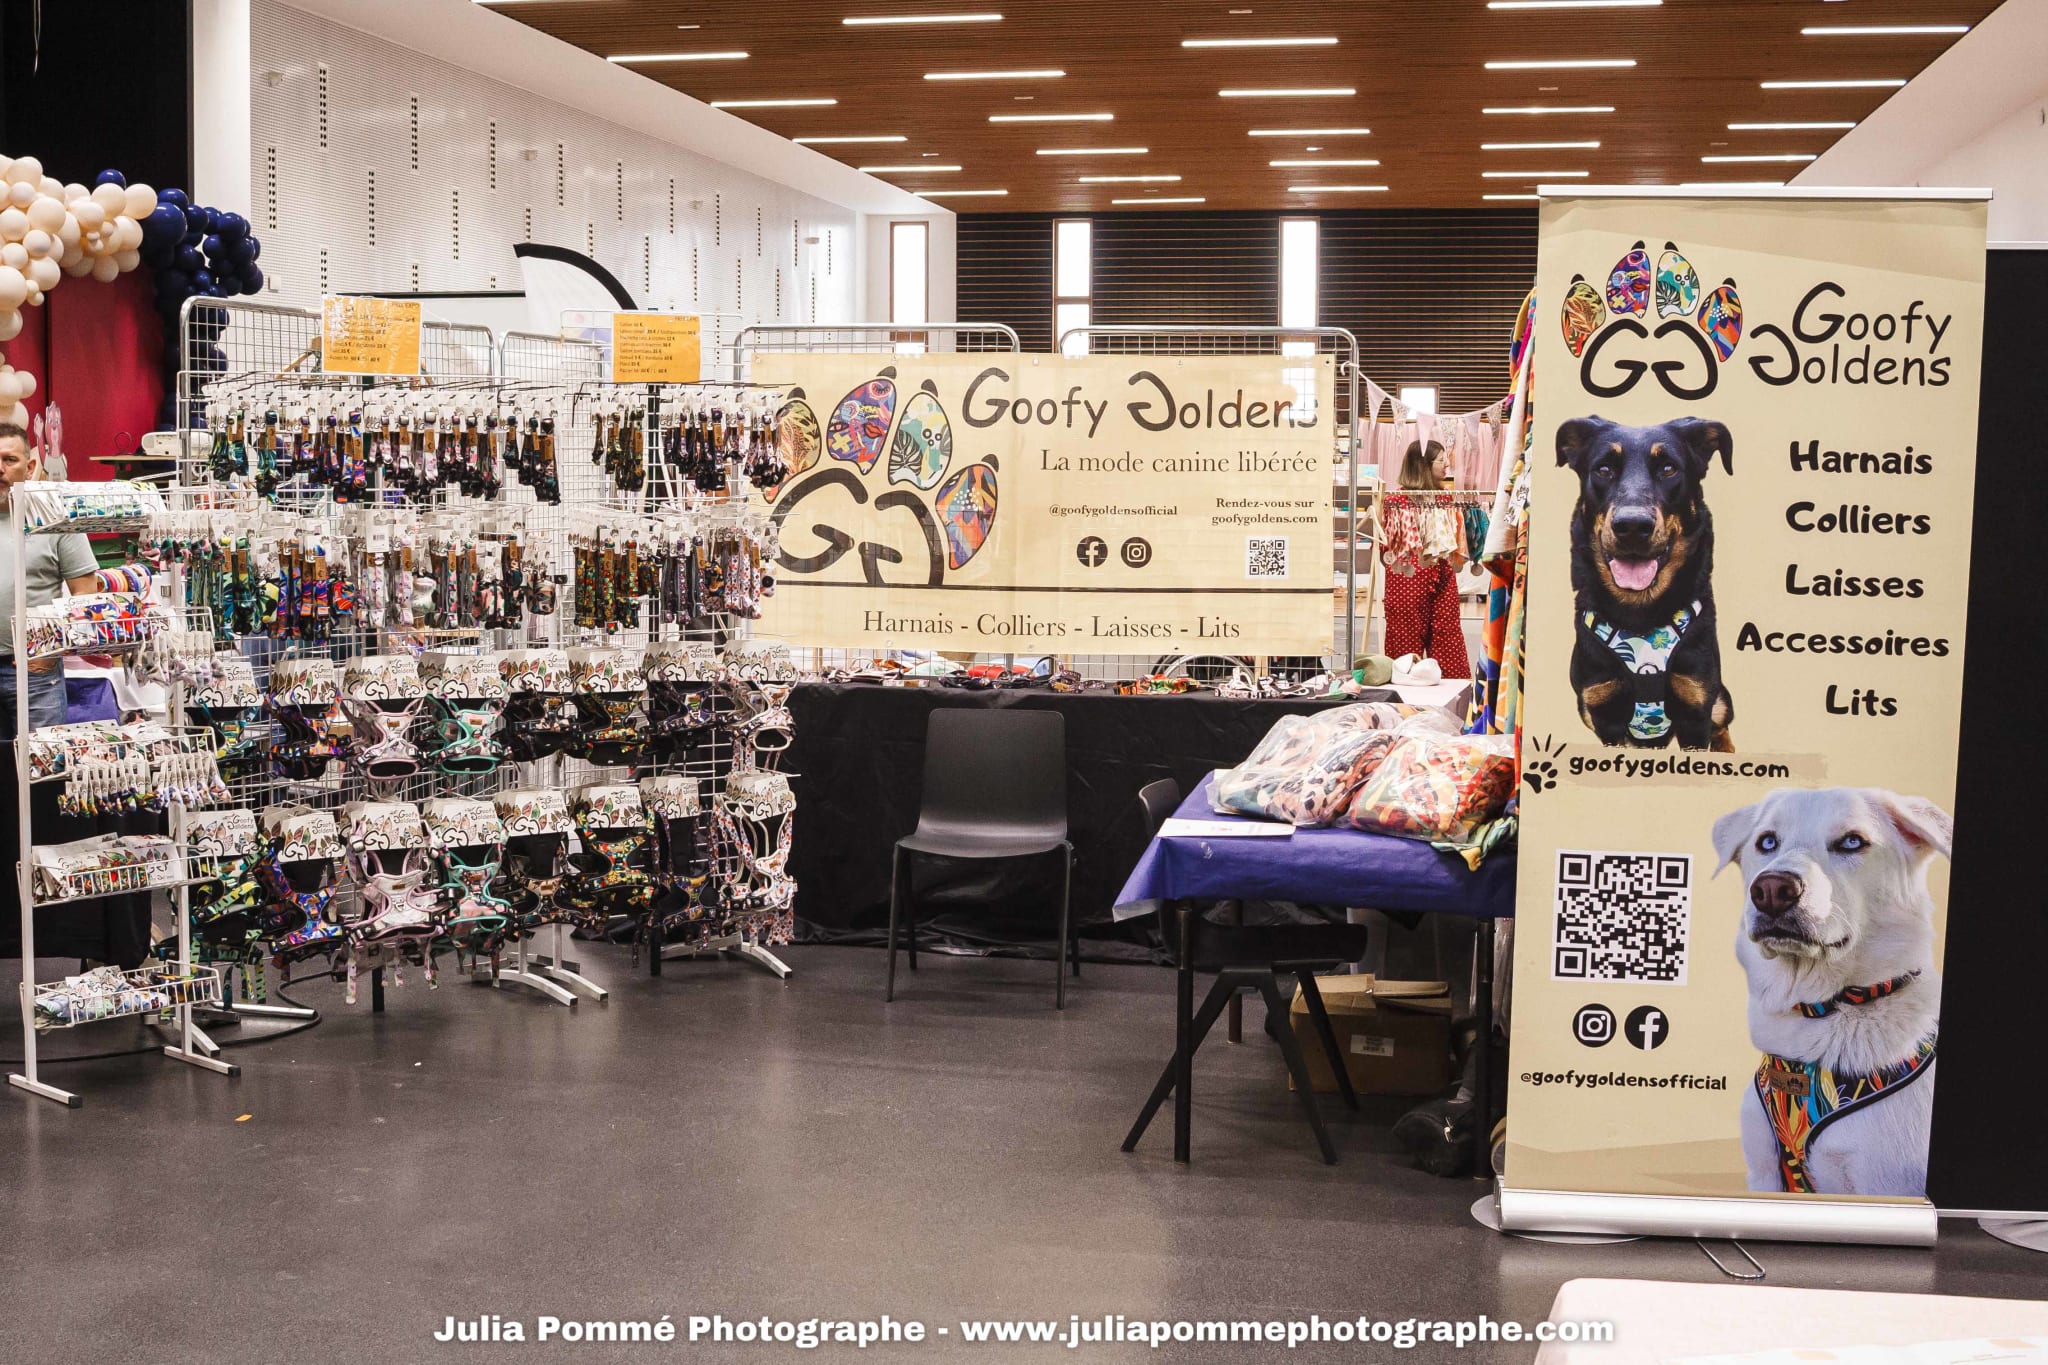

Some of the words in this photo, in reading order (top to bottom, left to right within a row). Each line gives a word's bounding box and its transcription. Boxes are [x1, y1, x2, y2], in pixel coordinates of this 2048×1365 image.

[1791, 281, 1952, 353] Goofy
[1748, 324, 1951, 387] Goldens
[962, 367, 1107, 438] Goofy
[1041, 449, 1071, 471] La
[1079, 451, 1144, 472] mode
[1152, 452, 1229, 473] canine
[1238, 450, 1318, 472] libérée
[1789, 440, 1933, 475] Harnais
[1049, 504, 1178, 518] @goofygoldensofficial
[1211, 513, 1318, 526] goofygoldens.com
[1215, 497, 1291, 509] Rendez-vous
[1293, 500, 1315, 509] sur
[1786, 501, 1931, 534] Colliers
[1786, 564, 1924, 599] Laisses
[863, 610, 953, 634] Harnais
[976, 613, 1066, 636] Colliers
[1091, 615, 1172, 638] Laisses
[1197, 616, 1240, 638] Lits
[1736, 622, 1950, 657] Accessoires
[1825, 684, 1898, 717] Lits
[1569, 753, 1790, 779] goofygoldens.com
[1520, 1069, 1727, 1091] @goofygoldensofficial
